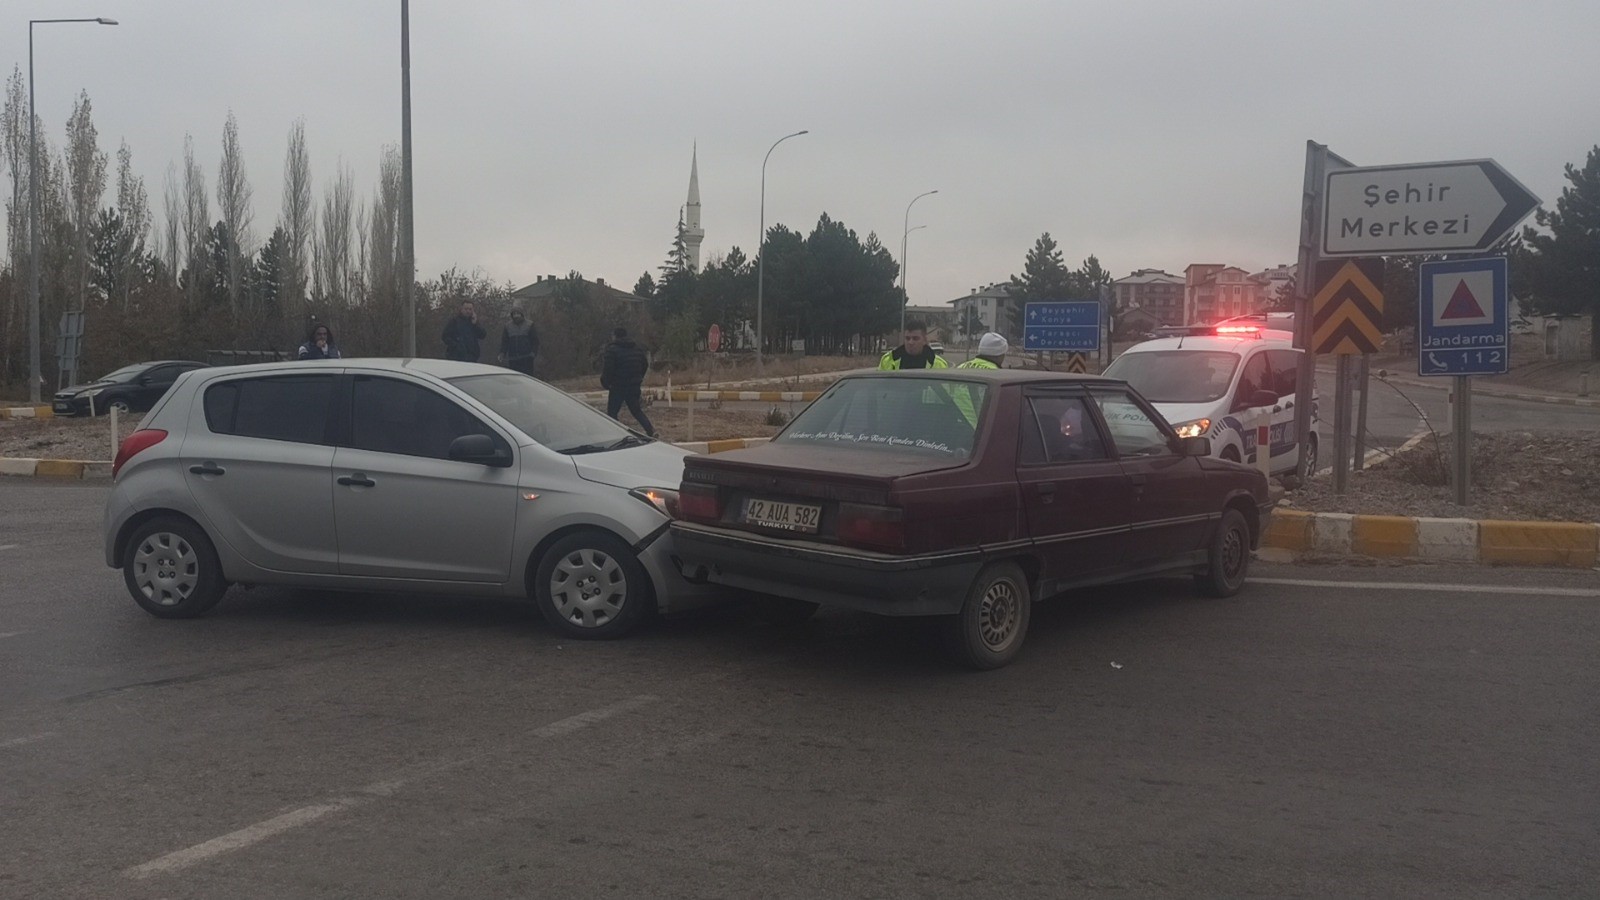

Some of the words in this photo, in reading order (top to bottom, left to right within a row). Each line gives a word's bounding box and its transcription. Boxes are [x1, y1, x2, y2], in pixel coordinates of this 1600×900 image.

[1364, 182, 1451, 207] Şehir
[1340, 214, 1469, 238] Merkezi
[1423, 334, 1505, 347] Jandarma
[1461, 351, 1501, 364] 112
[748, 501, 764, 519] 42
[767, 504, 789, 522] AUA
[794, 506, 818, 526] 582
